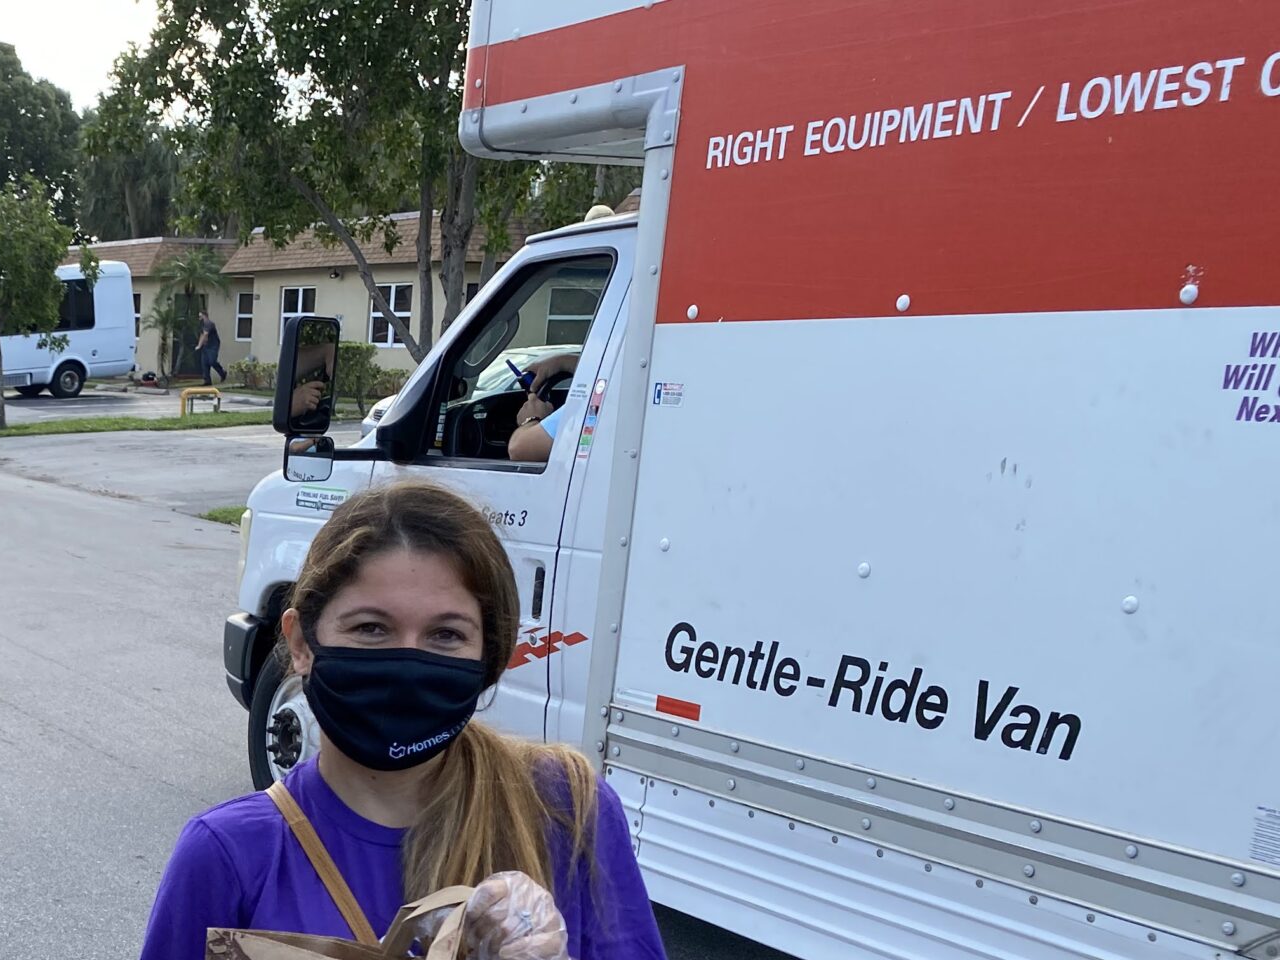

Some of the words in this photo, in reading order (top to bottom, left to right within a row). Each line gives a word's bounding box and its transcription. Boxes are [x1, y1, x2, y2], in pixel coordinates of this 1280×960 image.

[705, 124, 794, 170] RIGHT
[803, 90, 1013, 156] EQUIPMENT
[1055, 56, 1246, 123] LOWEST
[1222, 363, 1276, 391] Will
[481, 506, 516, 526] Seats
[518, 510, 528, 527] 3
[664, 621, 949, 730] Gentle-Ride
[974, 679, 1082, 761] Van
